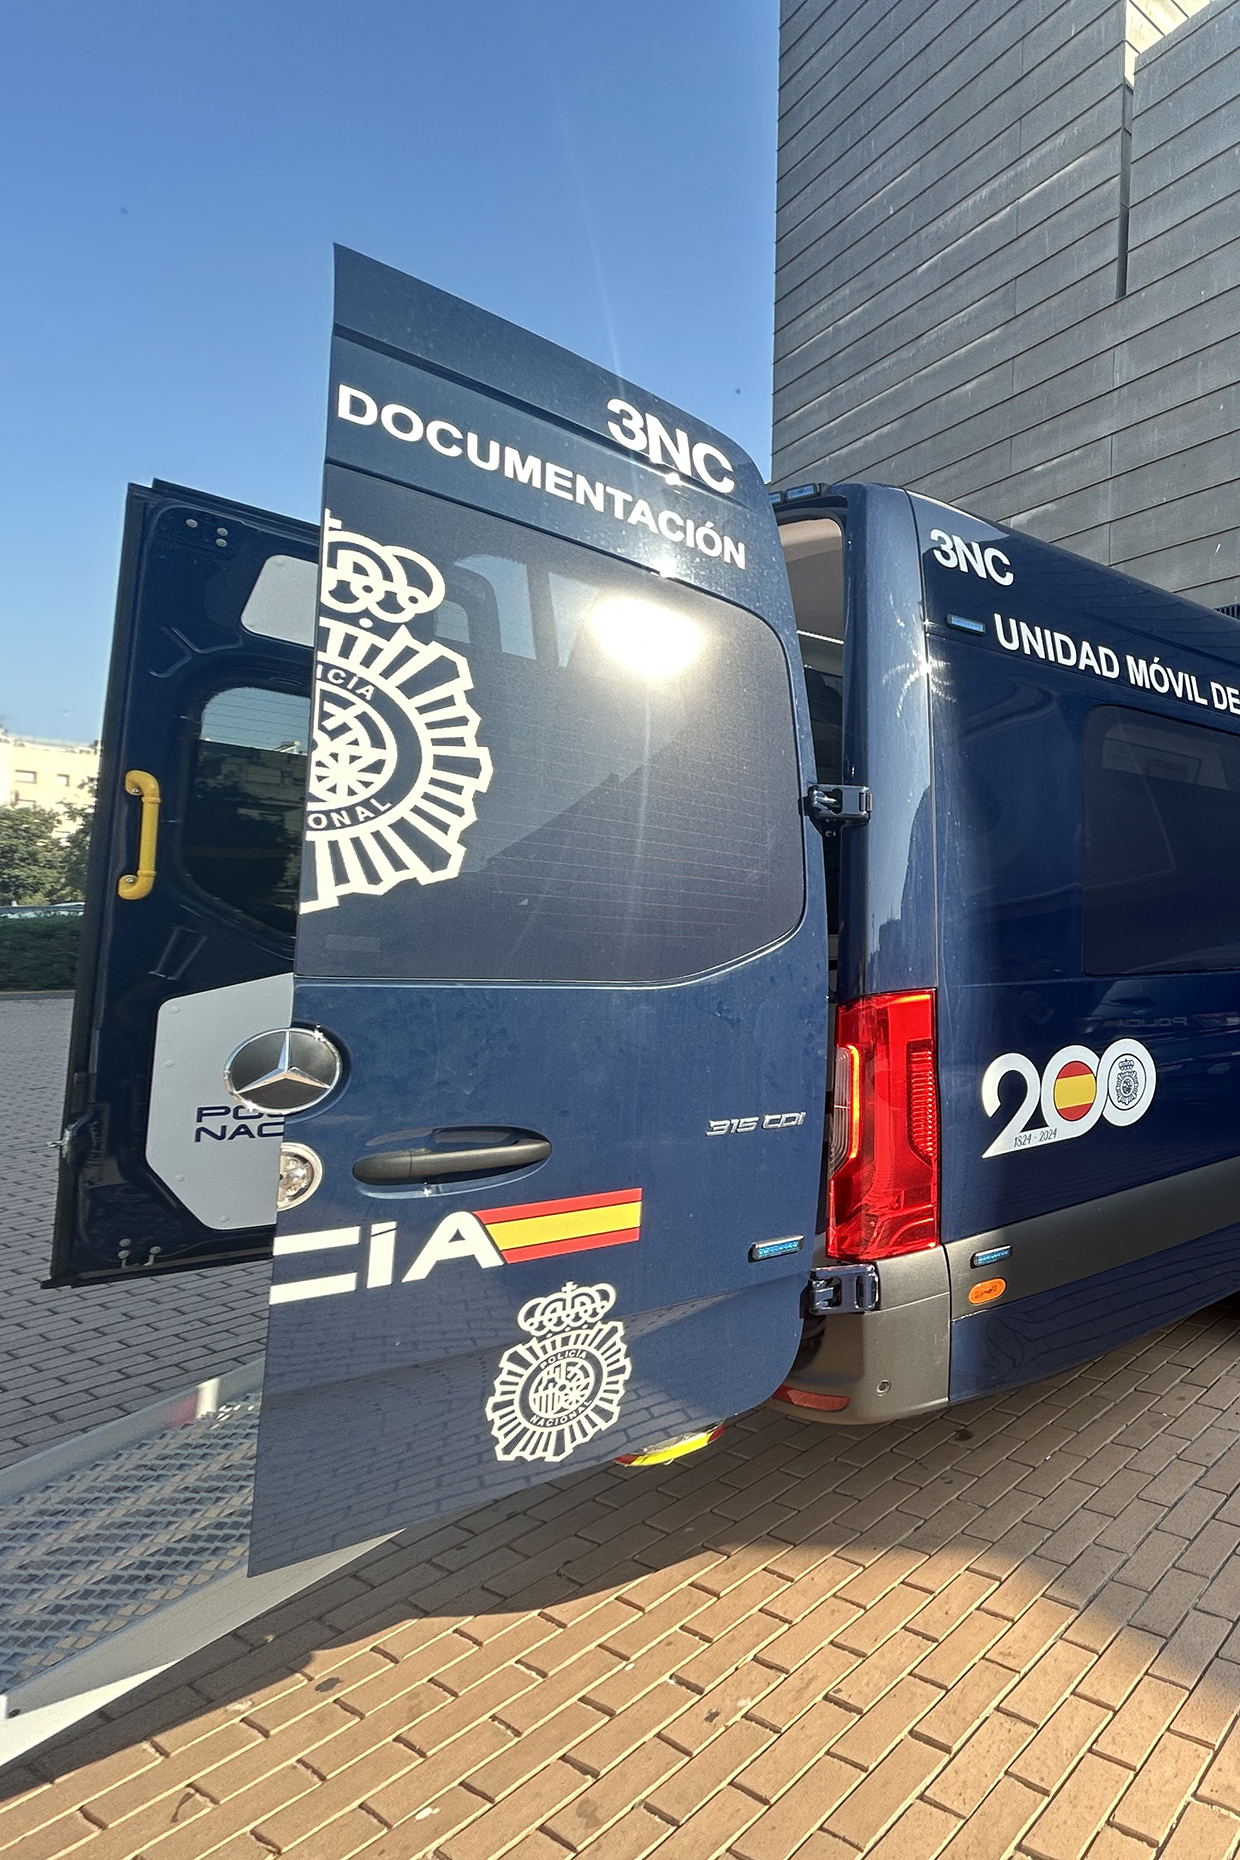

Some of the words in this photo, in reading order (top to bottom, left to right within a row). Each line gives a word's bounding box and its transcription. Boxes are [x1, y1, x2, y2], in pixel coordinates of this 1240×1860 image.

[606, 397, 736, 493] 3NC
[336, 383, 746, 571] DOCUMENTACIÓN
[929, 528, 1015, 587] 3NC
[993, 613, 1121, 681] UNIDAD
[1125, 656, 1208, 708] MÓVIL
[196, 1104, 285, 1123] PO
[705, 1116, 760, 1137] 315
[762, 1111, 807, 1129] CDI
[981, 1037, 1157, 1159] 200
[1013, 1133, 1032, 1148] 1824
[1039, 1127, 1058, 1142] 2024
[529, 1399, 593, 1427] NACIONAL
